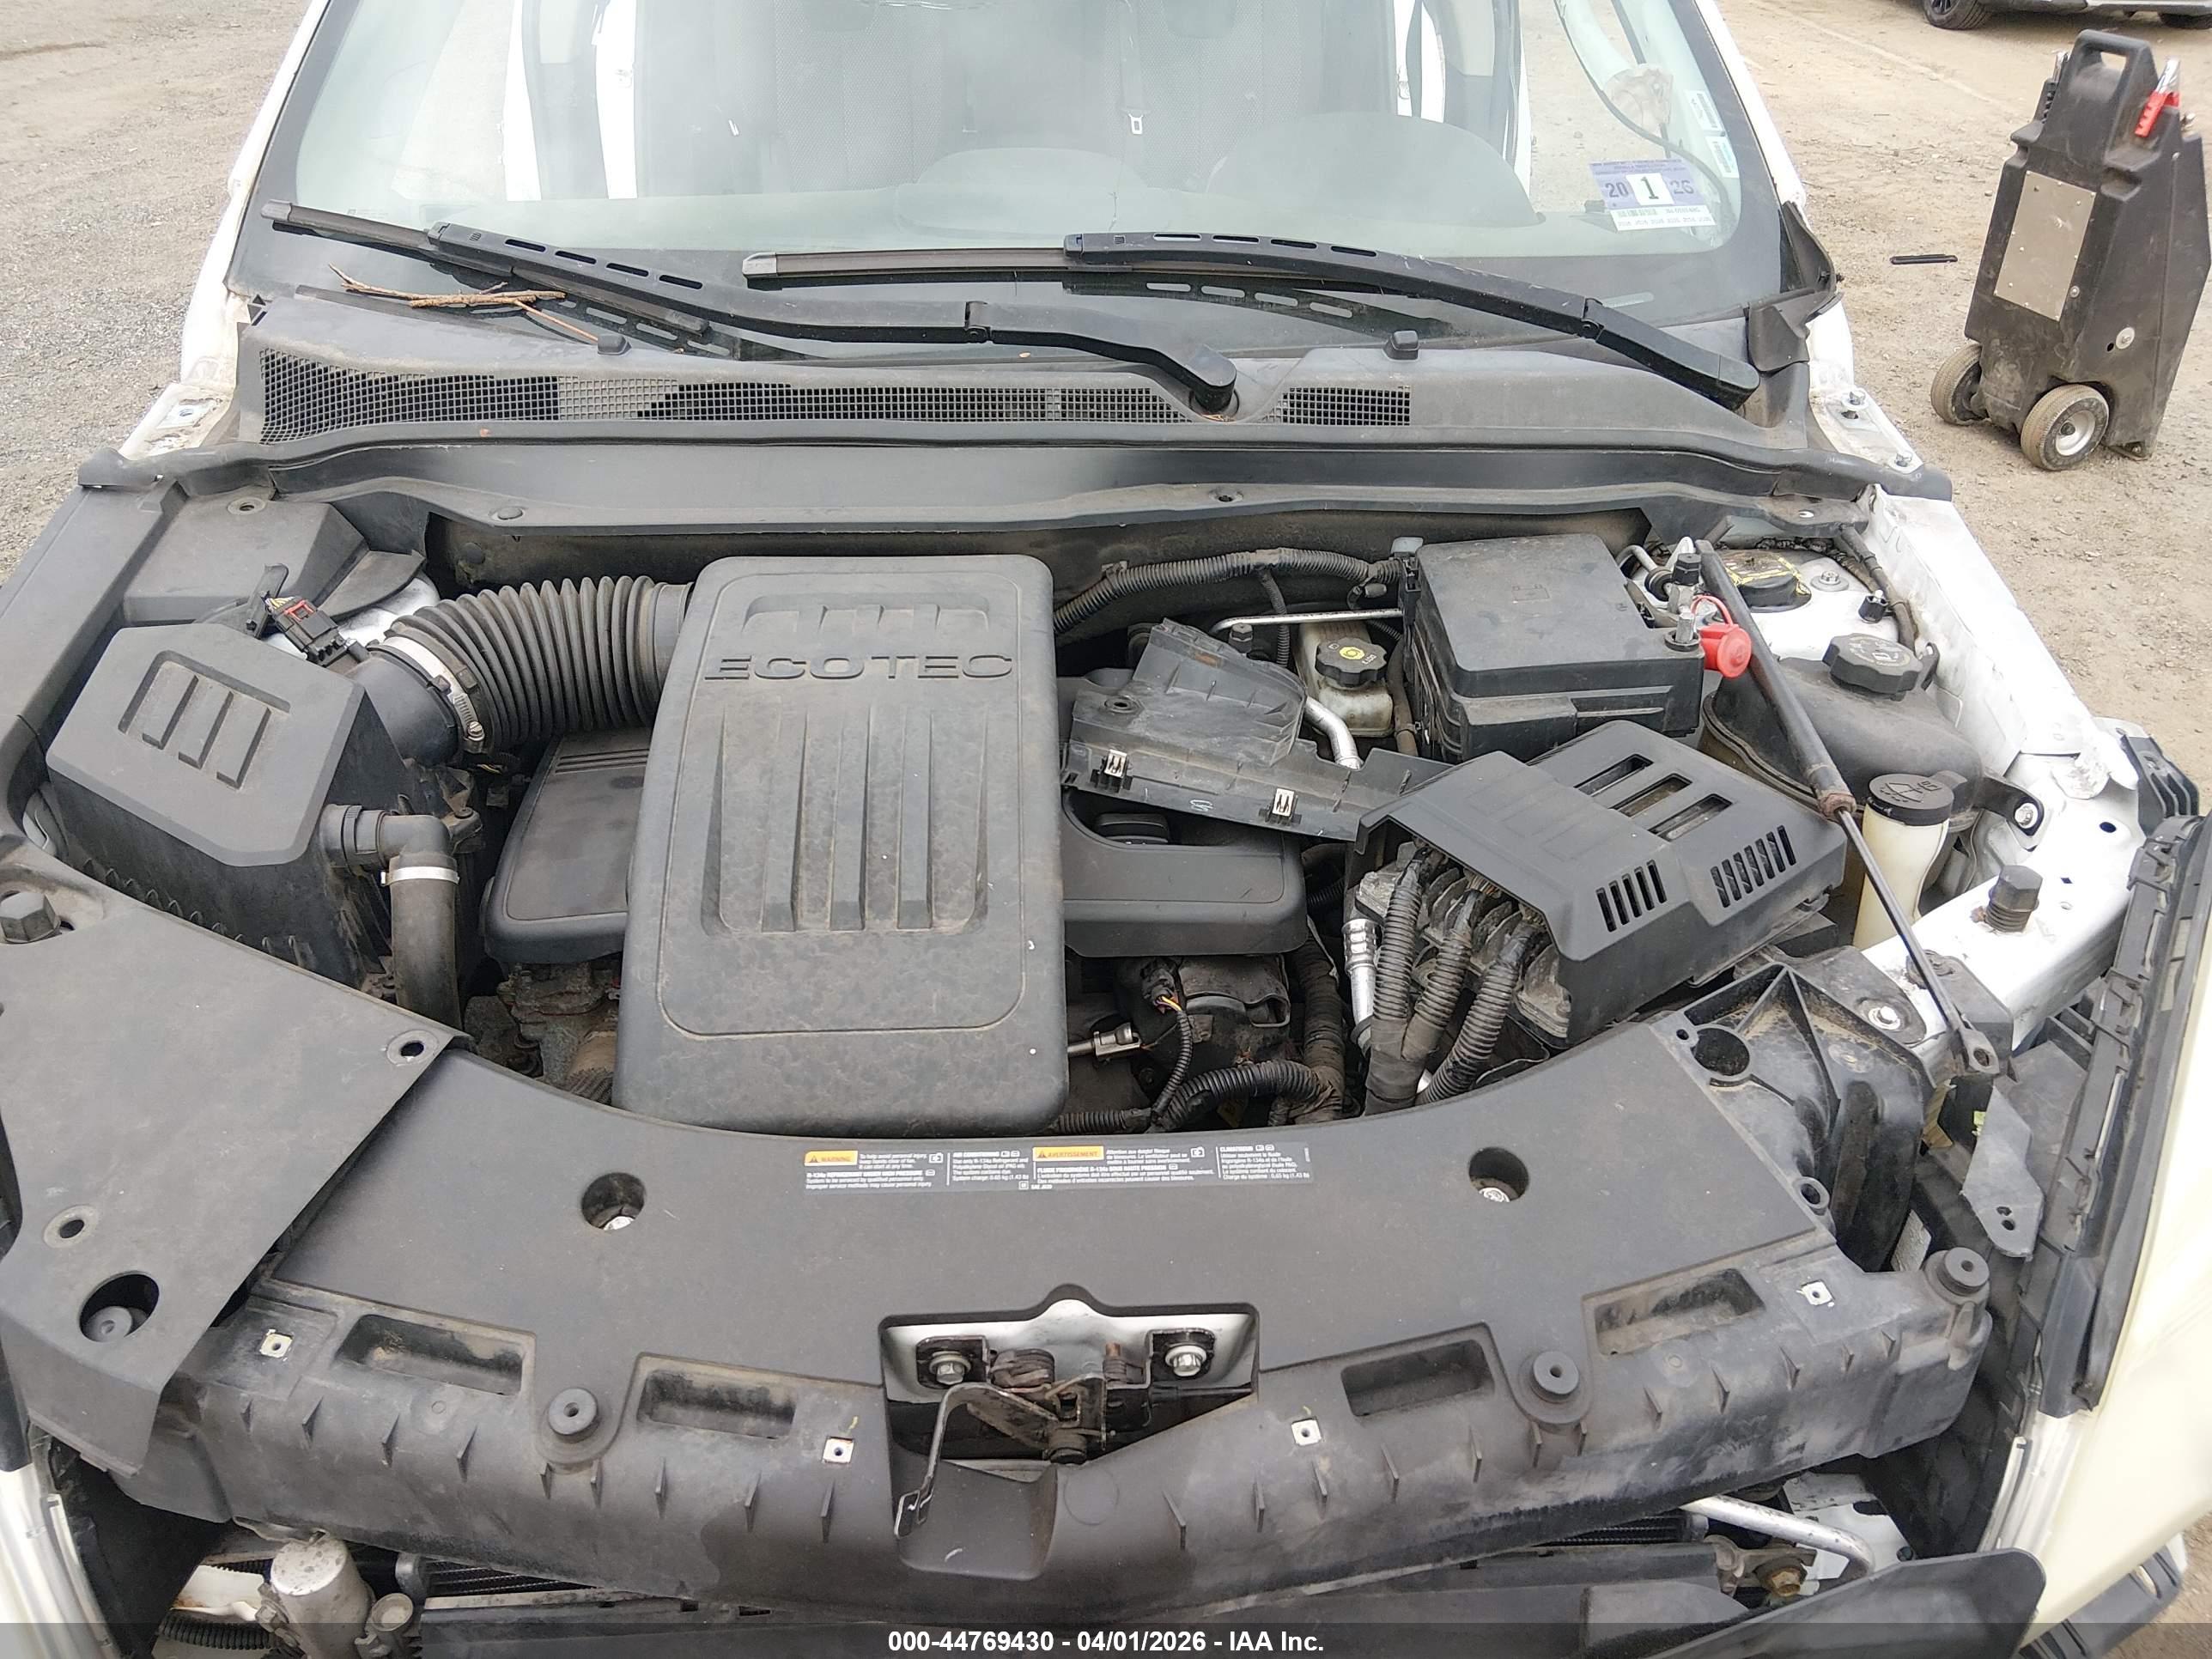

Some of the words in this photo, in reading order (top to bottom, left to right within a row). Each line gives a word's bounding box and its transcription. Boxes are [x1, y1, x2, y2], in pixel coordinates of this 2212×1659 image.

[1605, 181, 1629, 198] 20
[1640, 176, 1659, 199] 1
[704, 653, 1012, 680] ECOTEC
